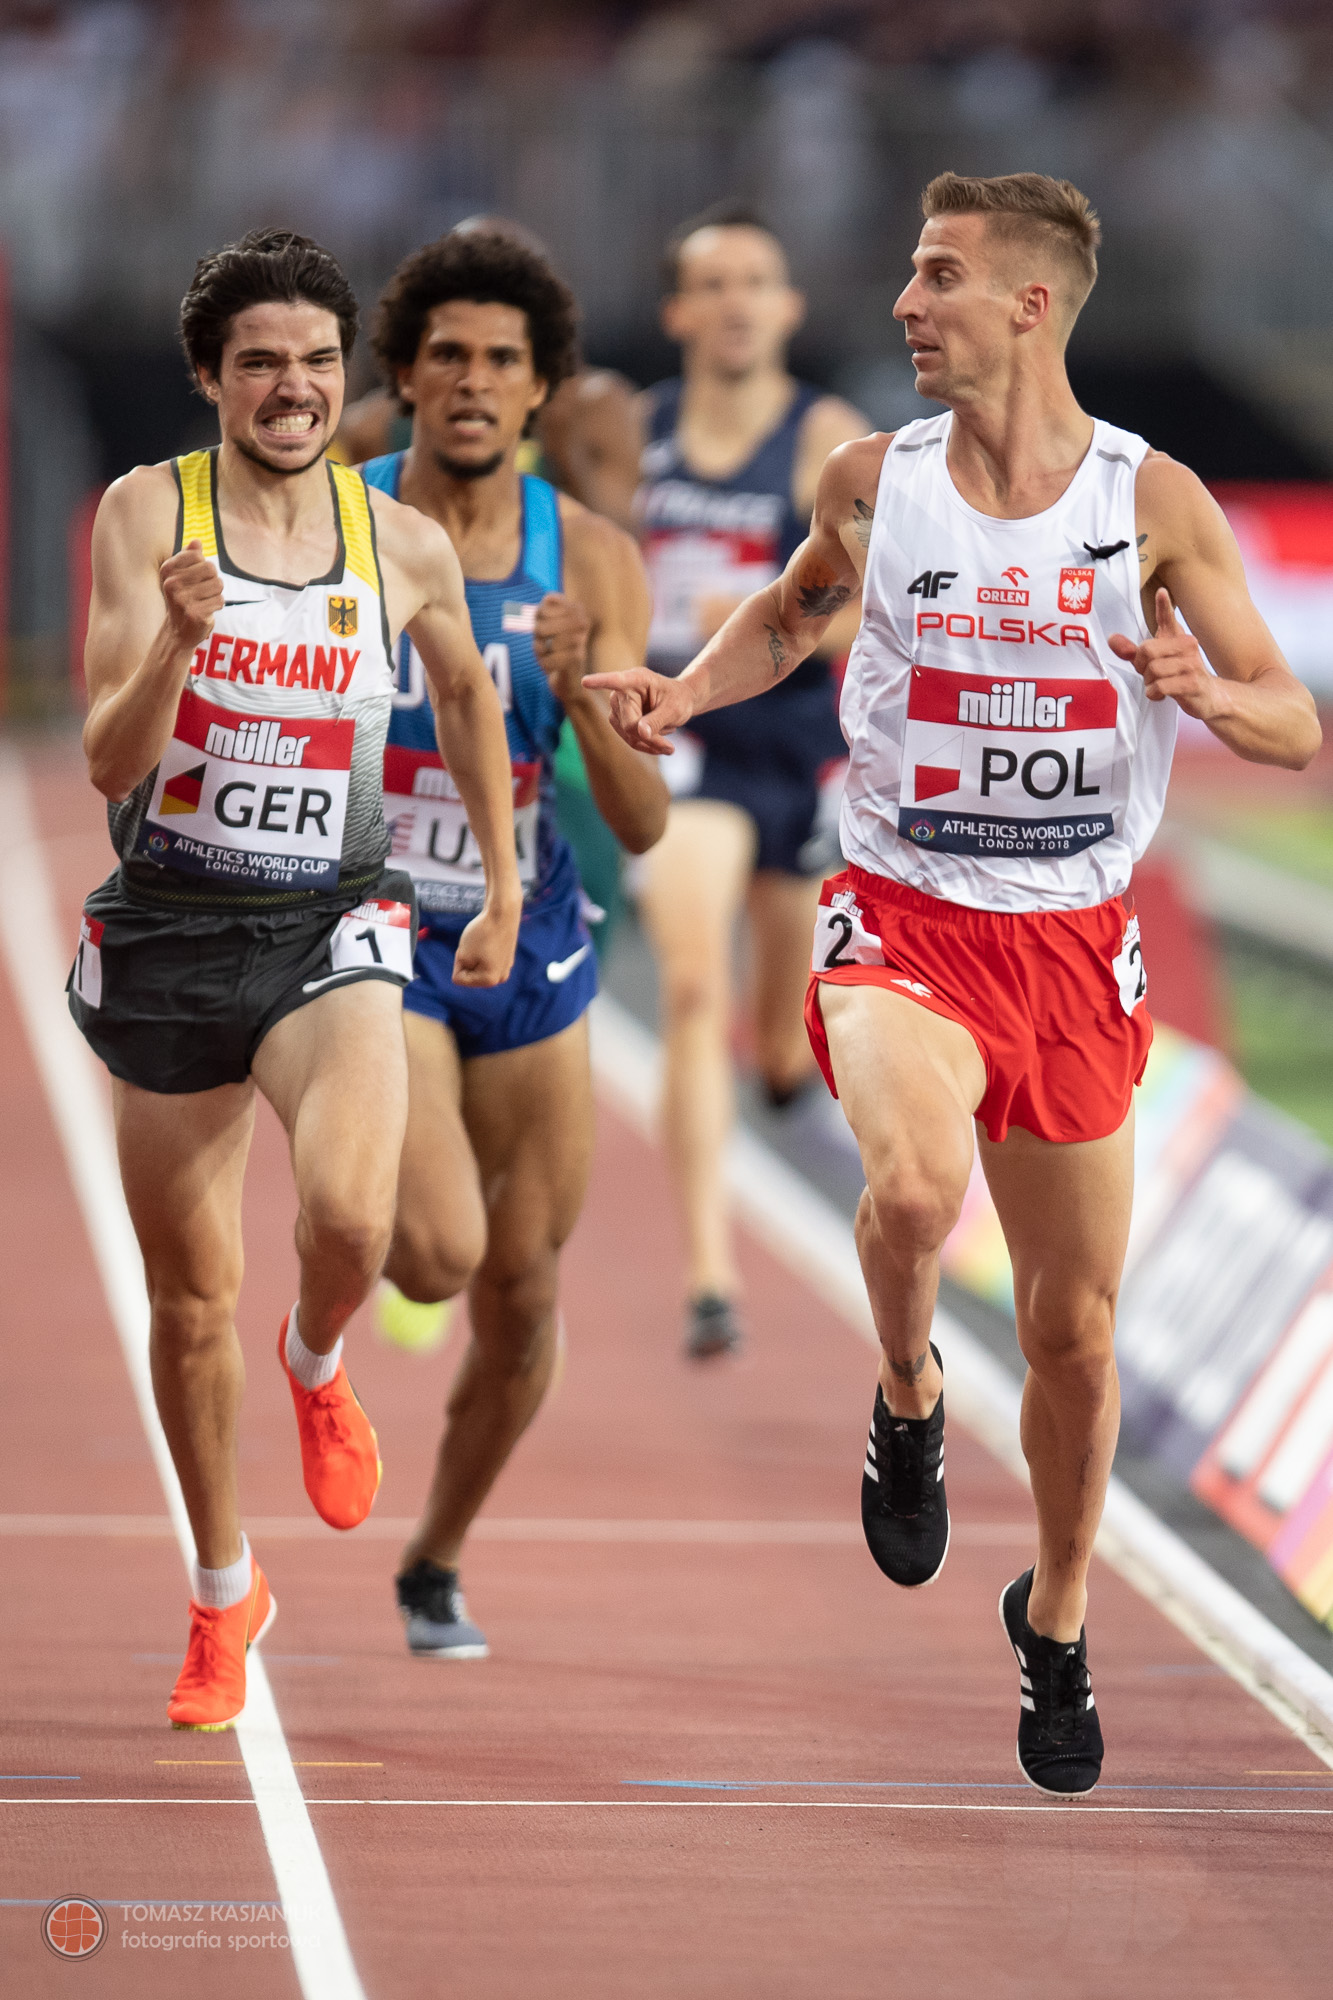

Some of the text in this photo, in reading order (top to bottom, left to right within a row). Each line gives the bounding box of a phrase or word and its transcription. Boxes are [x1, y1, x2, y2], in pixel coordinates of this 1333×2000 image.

[1062, 569, 1093, 577] POLSKA
[979, 589, 1027, 604] ORLEN
[916, 611, 1090, 648] POLSKA
[957, 681, 1073, 729] müller
[204, 720, 311, 767] müller
[980, 746, 1100, 801] POL
[213, 780, 333, 837] GER
[942, 819, 1106, 840] ATHLETICS WORLD CUP
[978, 837, 1070, 850] LONDON 2018
[174, 837, 330, 875] ATHLETICS WORLD CUP
[205, 860, 293, 882] LONDON 2018
[354, 925, 383, 964] 1
[823, 912, 857, 968] 2
